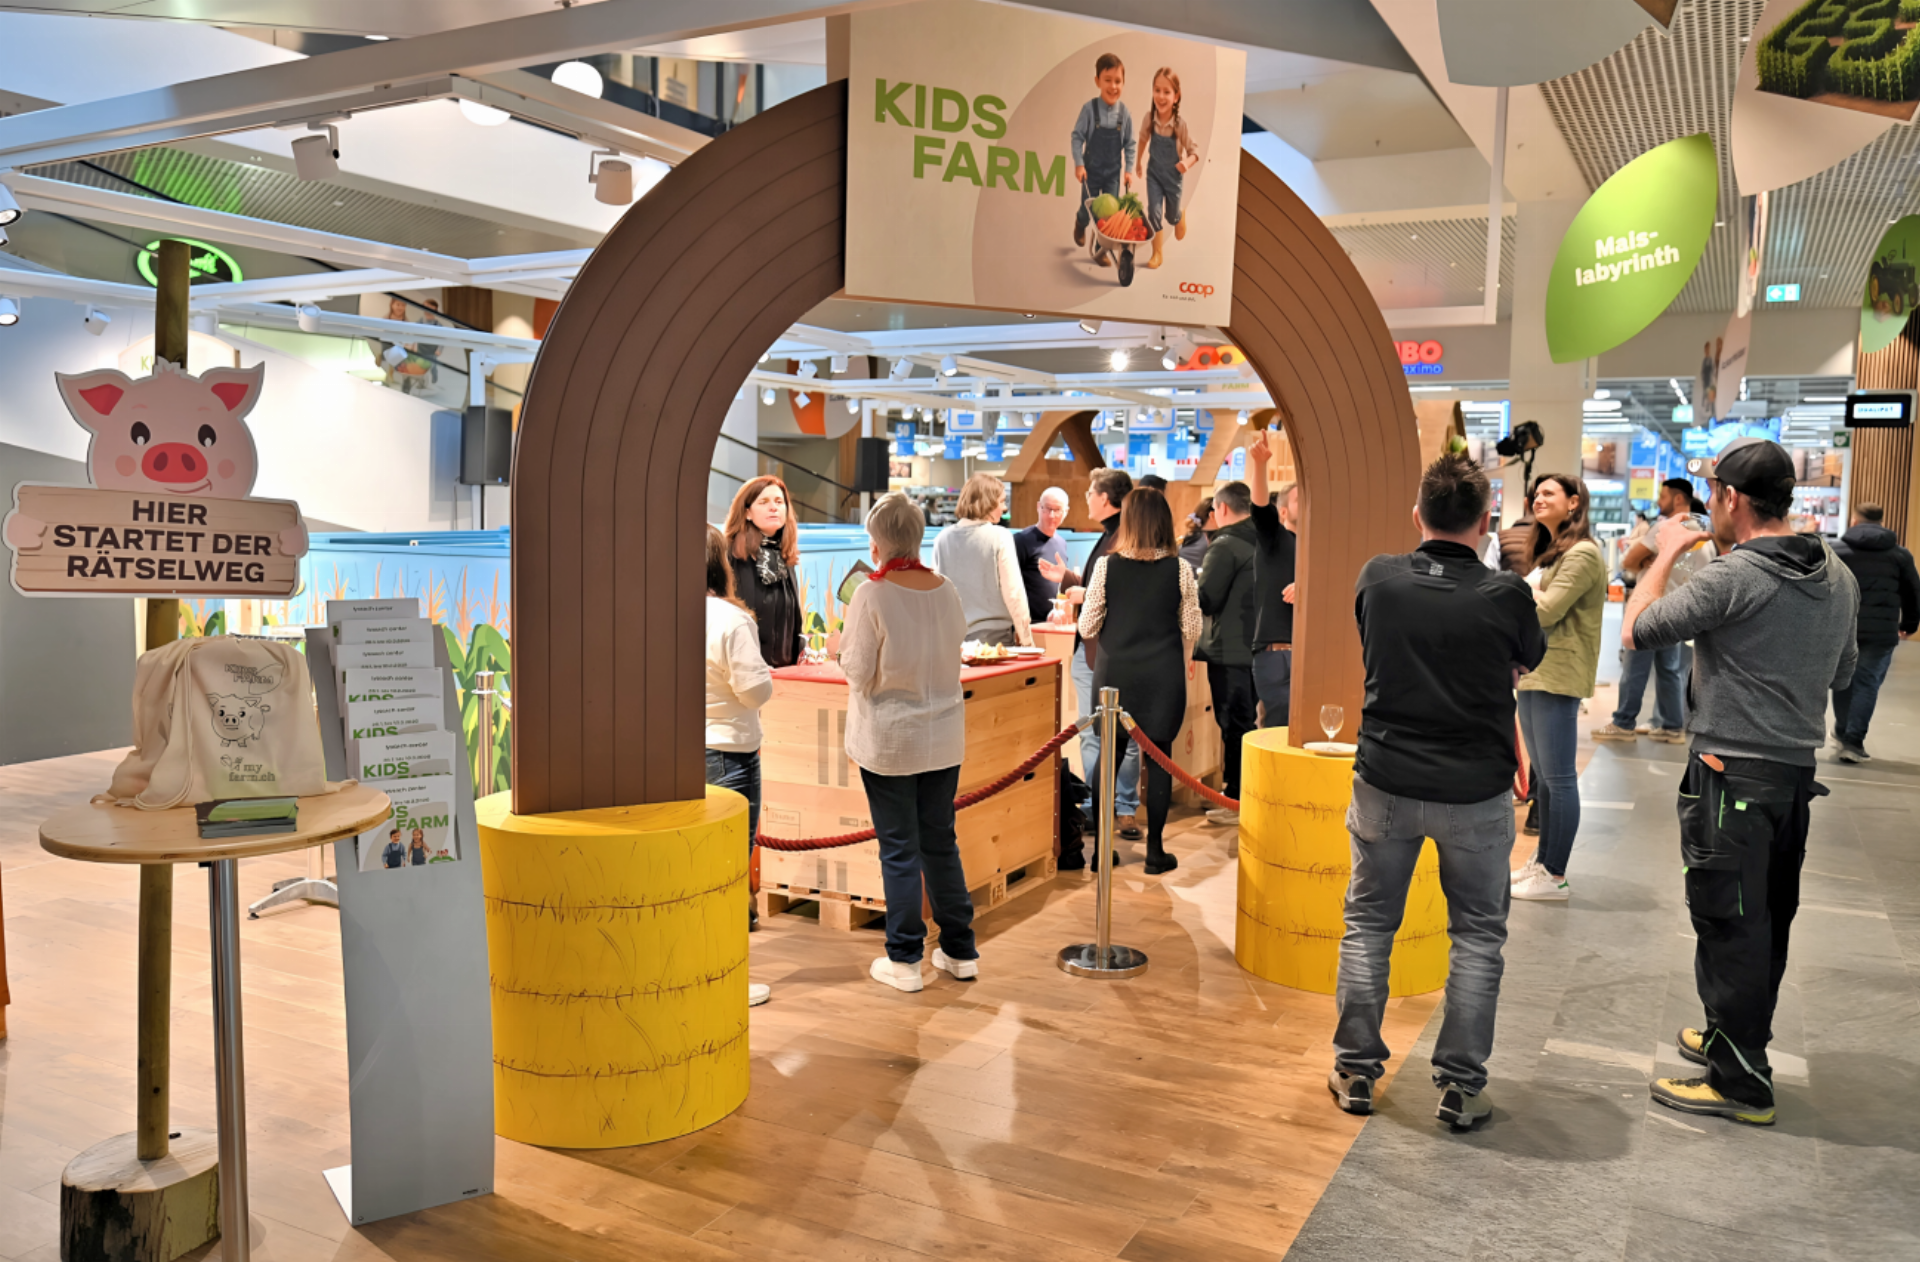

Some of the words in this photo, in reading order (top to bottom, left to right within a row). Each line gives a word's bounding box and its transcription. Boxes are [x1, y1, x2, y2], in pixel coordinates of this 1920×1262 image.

[875, 78, 1007, 139] KIDS
[913, 135, 1066, 196] FARM
[1595, 227, 1658, 259] Mais-
[1575, 244, 1680, 287] labyrinth
[1179, 282, 1214, 298] coop
[896, 424, 910, 437] 50
[131, 500, 208, 525] HIER
[53, 524, 206, 554] STARTET
[212, 532, 272, 557] DER
[66, 553, 265, 583] RÄTSELWEG
[352, 726, 399, 739] KIDS
[229, 772, 276, 782] farm.ch
[243, 763, 263, 774] my
[363, 762, 410, 778] KIDS
[396, 815, 449, 831] FARM
